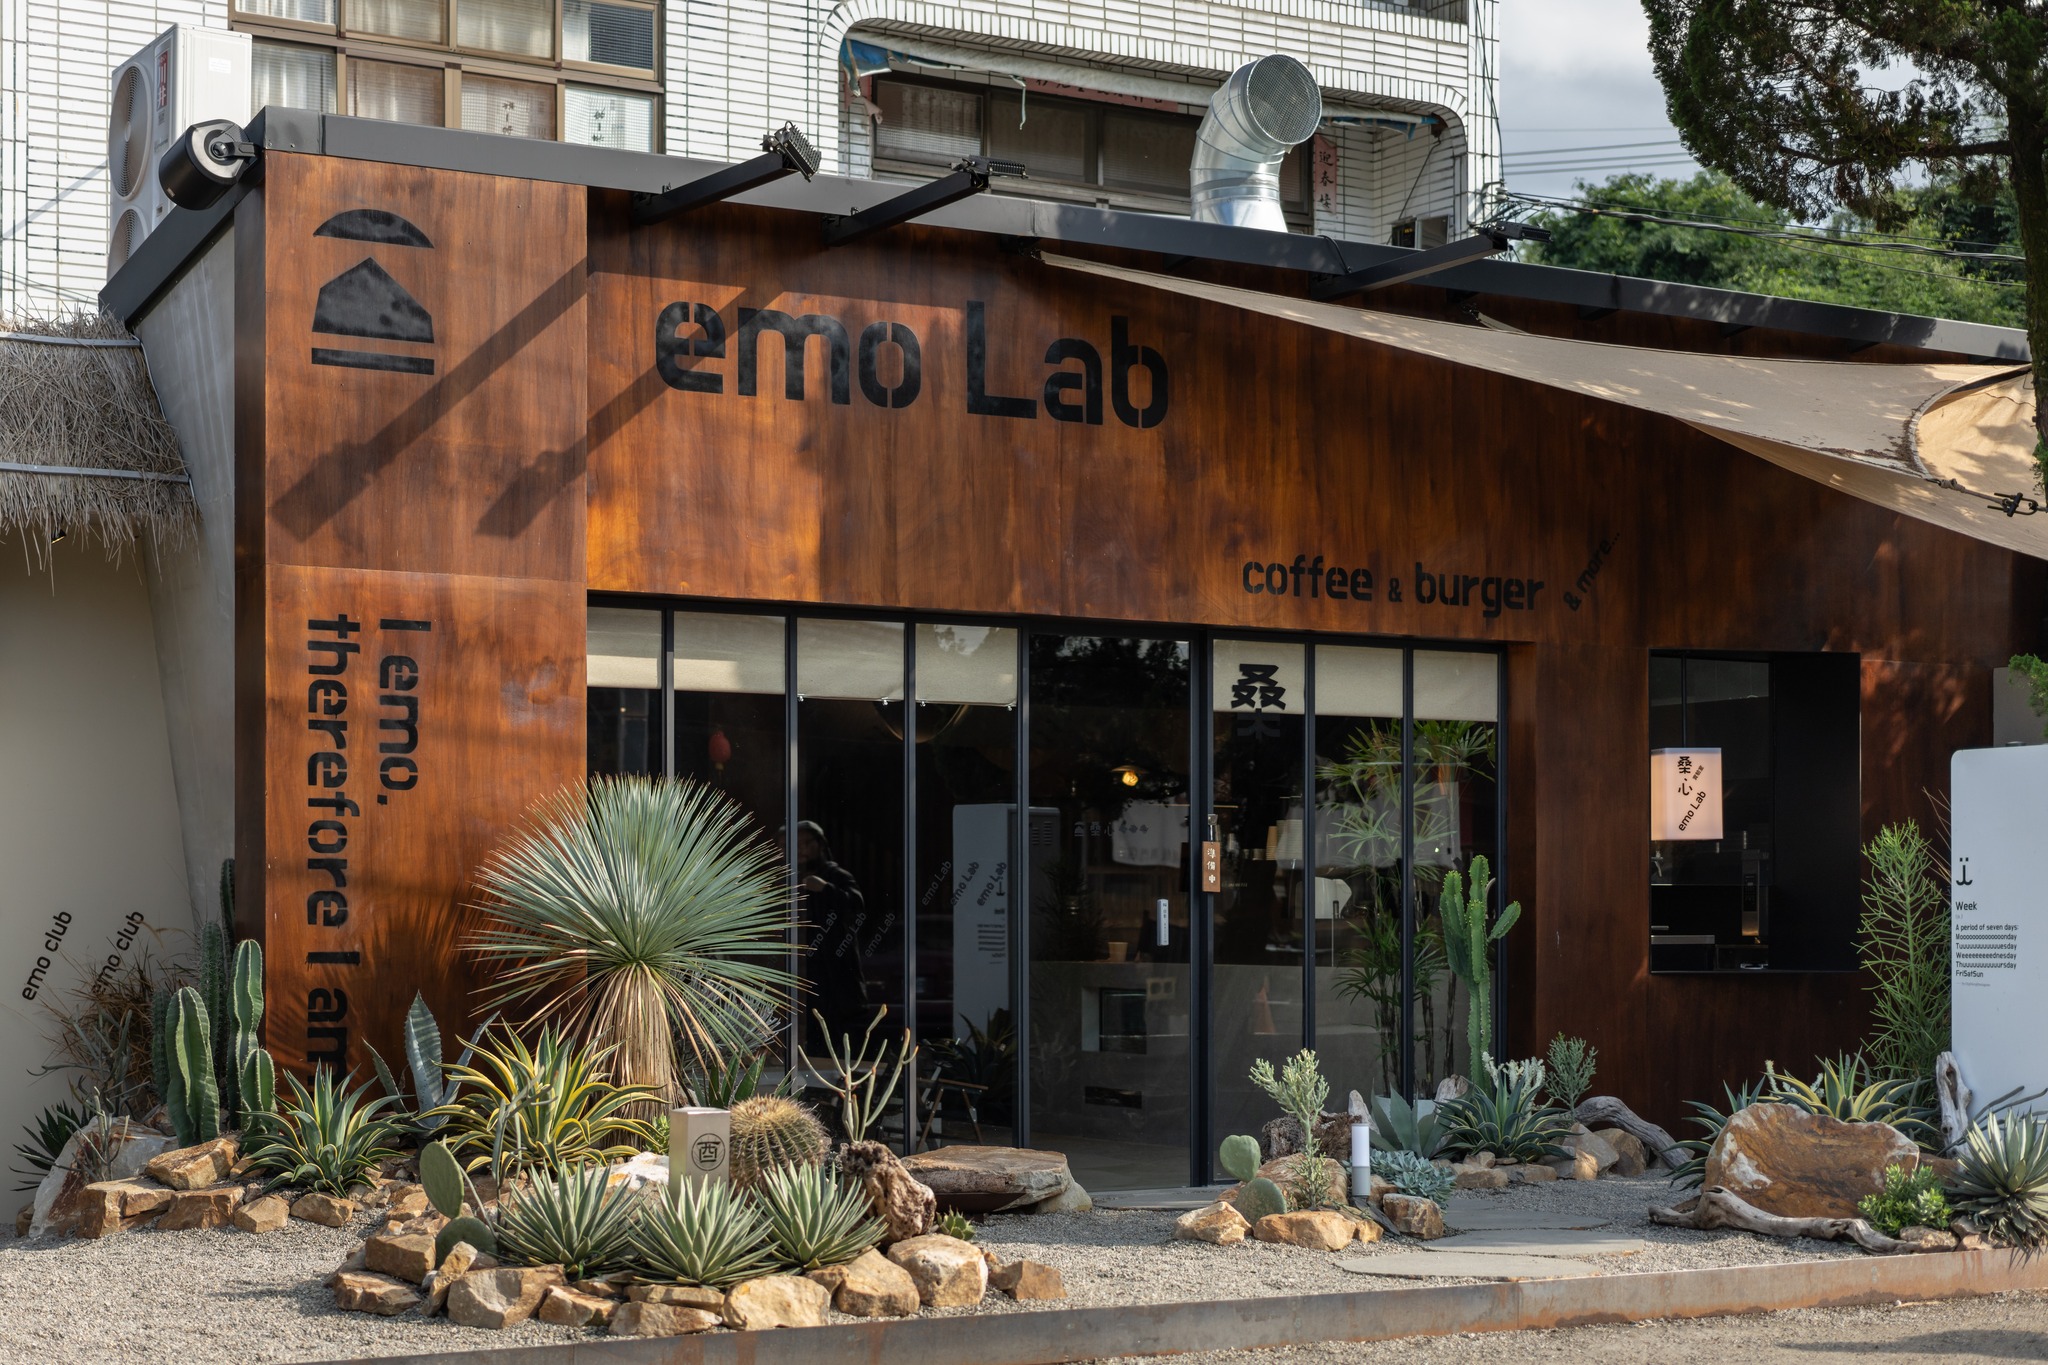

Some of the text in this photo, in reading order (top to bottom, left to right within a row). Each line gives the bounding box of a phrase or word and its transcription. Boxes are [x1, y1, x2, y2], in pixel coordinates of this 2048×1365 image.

[655, 299, 1169, 429] emo Lab
[1242, 554, 1545, 618] coffee & burger
[1231, 663, 1287, 743] 桑
[306, 613, 361, 928] therefore
[1677, 755, 1693, 796] 桑心
[1678, 791, 1707, 832] emo Lab
[1955, 901, 1977, 911] Week
[115, 911, 145, 951] club
[1961, 924, 1978, 932] period
[21, 911, 72, 1001] emo club
[1955, 970, 1983, 978] FriSatSun
